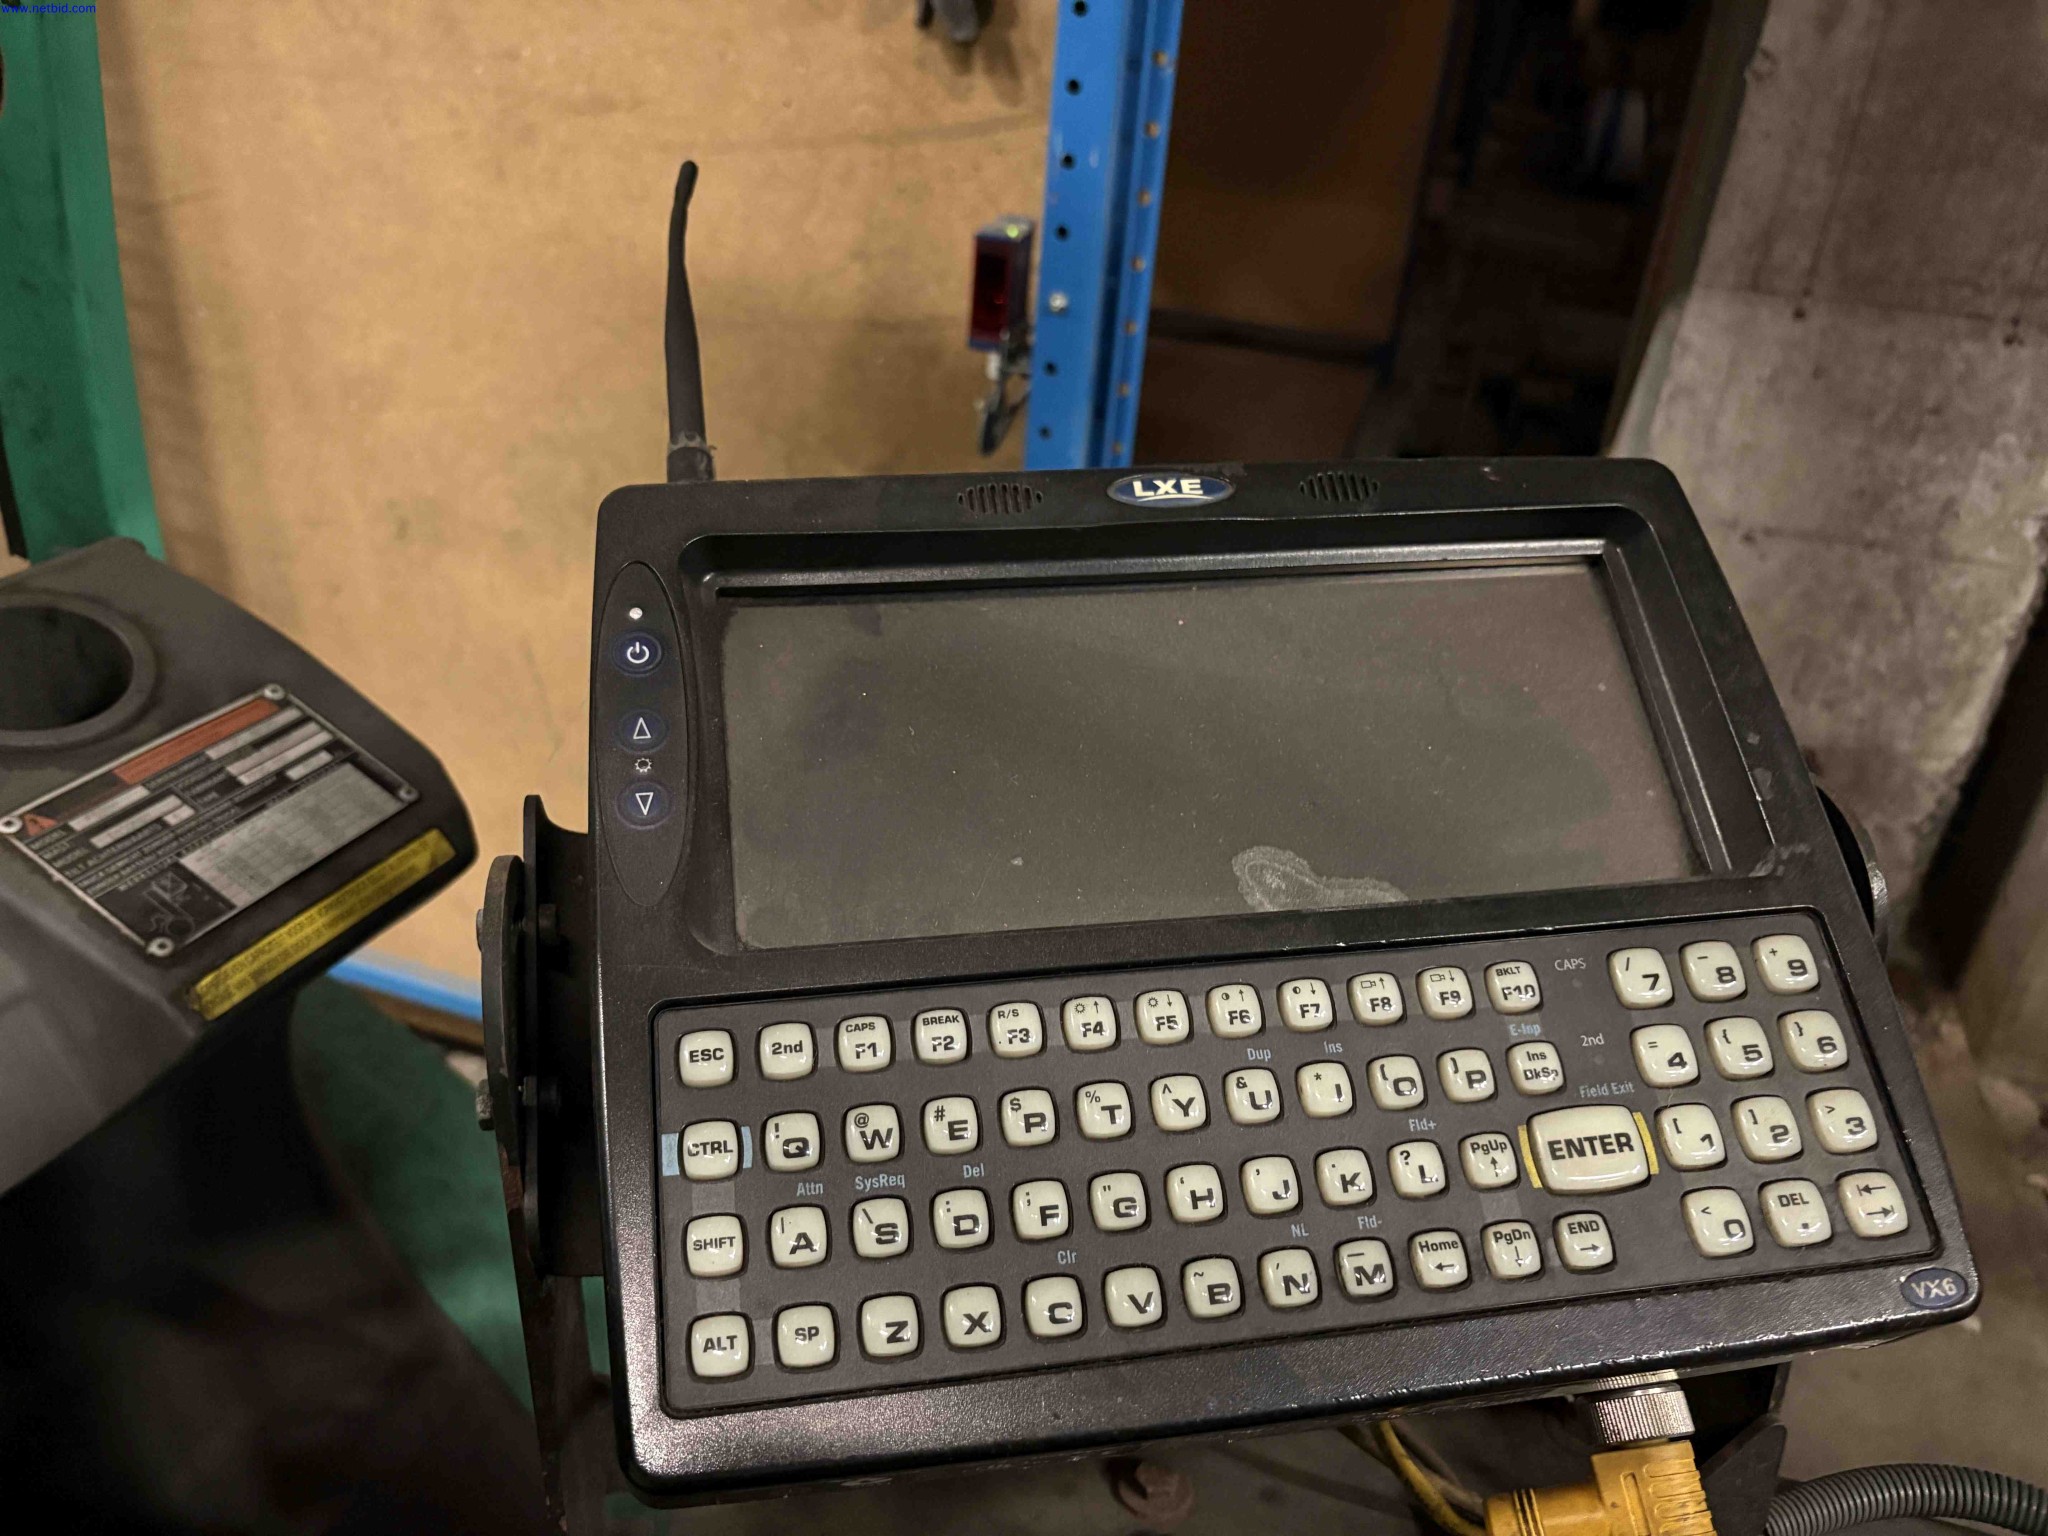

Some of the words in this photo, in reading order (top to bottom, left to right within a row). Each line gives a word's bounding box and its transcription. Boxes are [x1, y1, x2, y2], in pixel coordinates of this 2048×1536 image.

[1133, 479, 1203, 497] LXE
[1769, 948, 1778, 956] +
[1496, 966, 1520, 976] BKLT
[1555, 958, 1586, 971] CAPS
[1788, 960, 1807, 976] 9
[1642, 974, 1659, 991] 7
[1716, 967, 1736, 984] 8
[1440, 990, 1461, 1005] F9
[1502, 984, 1535, 1001] F10
[1300, 1003, 1320, 1018] F7
[1370, 997, 1391, 1012] F8
[922, 1015, 959, 1026] BREAK
[997, 1008, 1019, 1019] R/S
[1228, 1010, 1251, 1025] F6
[846, 1022, 875, 1033] CAPS
[1081, 1021, 1104, 1037] F4
[1155, 1015, 1178, 1031] F5
[932, 1036, 955, 1052] F2
[1007, 1028, 1030, 1044] F3
[1581, 1034, 1604, 1046] 2nd
[771, 1040, 803, 1055] 2nd
[855, 1042, 877, 1059] F1
[1324, 1042, 1343, 1054] Ins
[1743, 1044, 1762, 1062] 5
[1817, 1037, 1836, 1054] 6
[689, 1048, 724, 1063] ESC
[1247, 1049, 1272, 1060] Dup
[1527, 1051, 1546, 1061] Ins
[1668, 1053, 1687, 1070] 4
[1236, 1077, 1247, 1089] &
[1393, 1077, 1417, 1096] O
[1466, 1070, 1487, 1089] P
[1085, 1090, 1100, 1103] %
[1580, 1083, 1609, 1098] Field
[1612, 1082, 1634, 1095] Exit
[1009, 1098, 1021, 1112] $
[1172, 1097, 1195, 1117] Y
[1249, 1090, 1272, 1110] U
[854, 1113, 869, 1128] @
[934, 1106, 946, 1122] #
[1101, 1105, 1122, 1124] T
[774, 1123, 780, 1139] !
[948, 1120, 968, 1140] E
[1409, 1118, 1436, 1131] Fld+
[1846, 1117, 1865, 1136] 3
[860, 1128, 893, 1150] W
[1701, 1134, 1714, 1150] 1
[1770, 1125, 1789, 1143] 2
[687, 1140, 733, 1157] CTRL
[782, 1137, 810, 1158] Q
[1471, 1140, 1508, 1155] PgUp
[1547, 1132, 1635, 1160] ENTER
[1400, 1151, 1411, 1166] ?
[963, 1163, 985, 1178] Del
[1419, 1165, 1439, 1184] L
[796, 1182, 824, 1196] Attn
[855, 1174, 905, 1191] SysReq
[1272, 1180, 1289, 1200] J
[1340, 1172, 1365, 1193] K
[1190, 1188, 1214, 1209] H
[1778, 1193, 1809, 1207] DEL
[1040, 1205, 1059, 1226] F
[1112, 1197, 1137, 1218] G
[953, 1214, 979, 1236] D
[1291, 1224, 1309, 1237] NL
[1567, 1221, 1600, 1234] END
[875, 1223, 898, 1245] S
[1493, 1229, 1531, 1244] PgDn
[693, 1236, 736, 1251] SHIFT
[789, 1232, 818, 1255] A
[1419, 1240, 1459, 1253] Home
[1057, 1251, 1077, 1264] Clr
[1354, 1264, 1387, 1286] M
[1282, 1273, 1310, 1296] N
[1912, 1278, 1957, 1299] VX6
[1207, 1283, 1233, 1305] B
[1127, 1292, 1153, 1314] V
[1048, 1302, 1073, 1324] C
[963, 1311, 992, 1335] X
[795, 1326, 819, 1341] SP
[885, 1320, 910, 1344] Z
[703, 1335, 737, 1352] ALT
